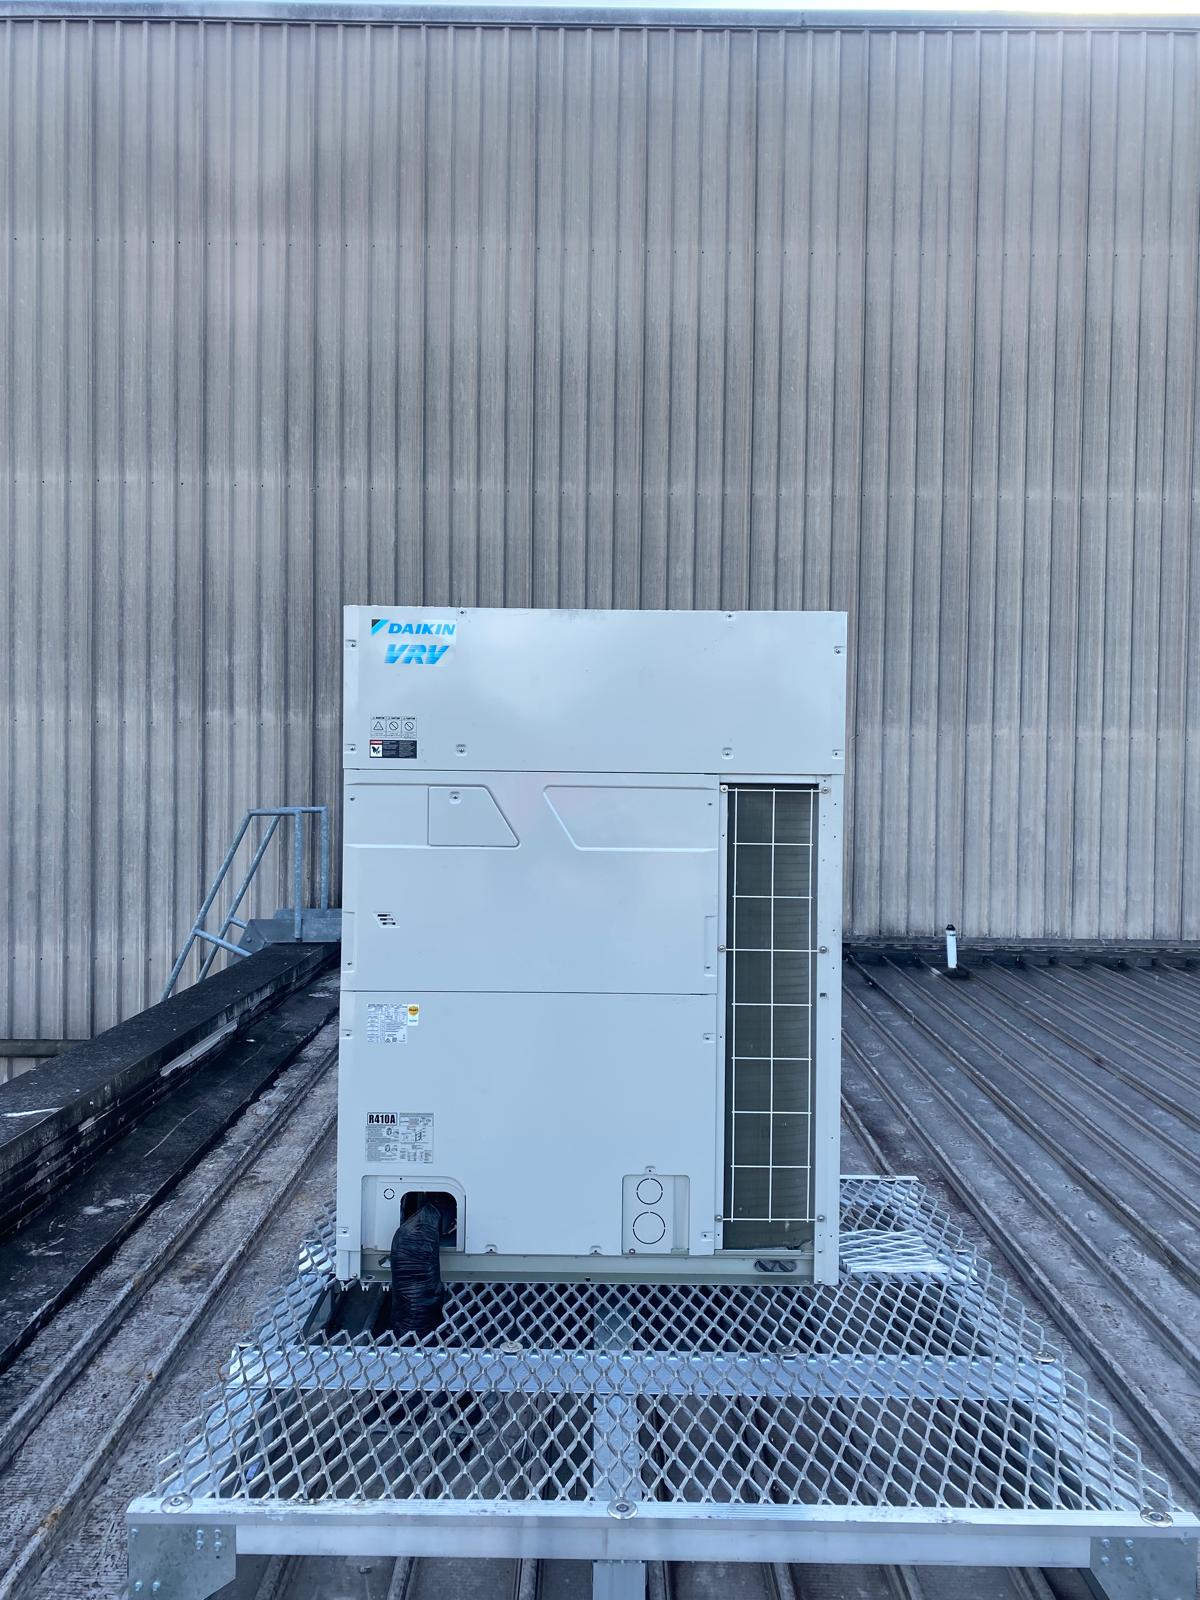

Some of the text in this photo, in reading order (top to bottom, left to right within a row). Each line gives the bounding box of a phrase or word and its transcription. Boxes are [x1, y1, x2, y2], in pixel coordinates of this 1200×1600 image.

[388, 623, 456, 635] DAIKIN
[384, 644, 450, 665] VRV
[368, 1114, 396, 1124] R410A
